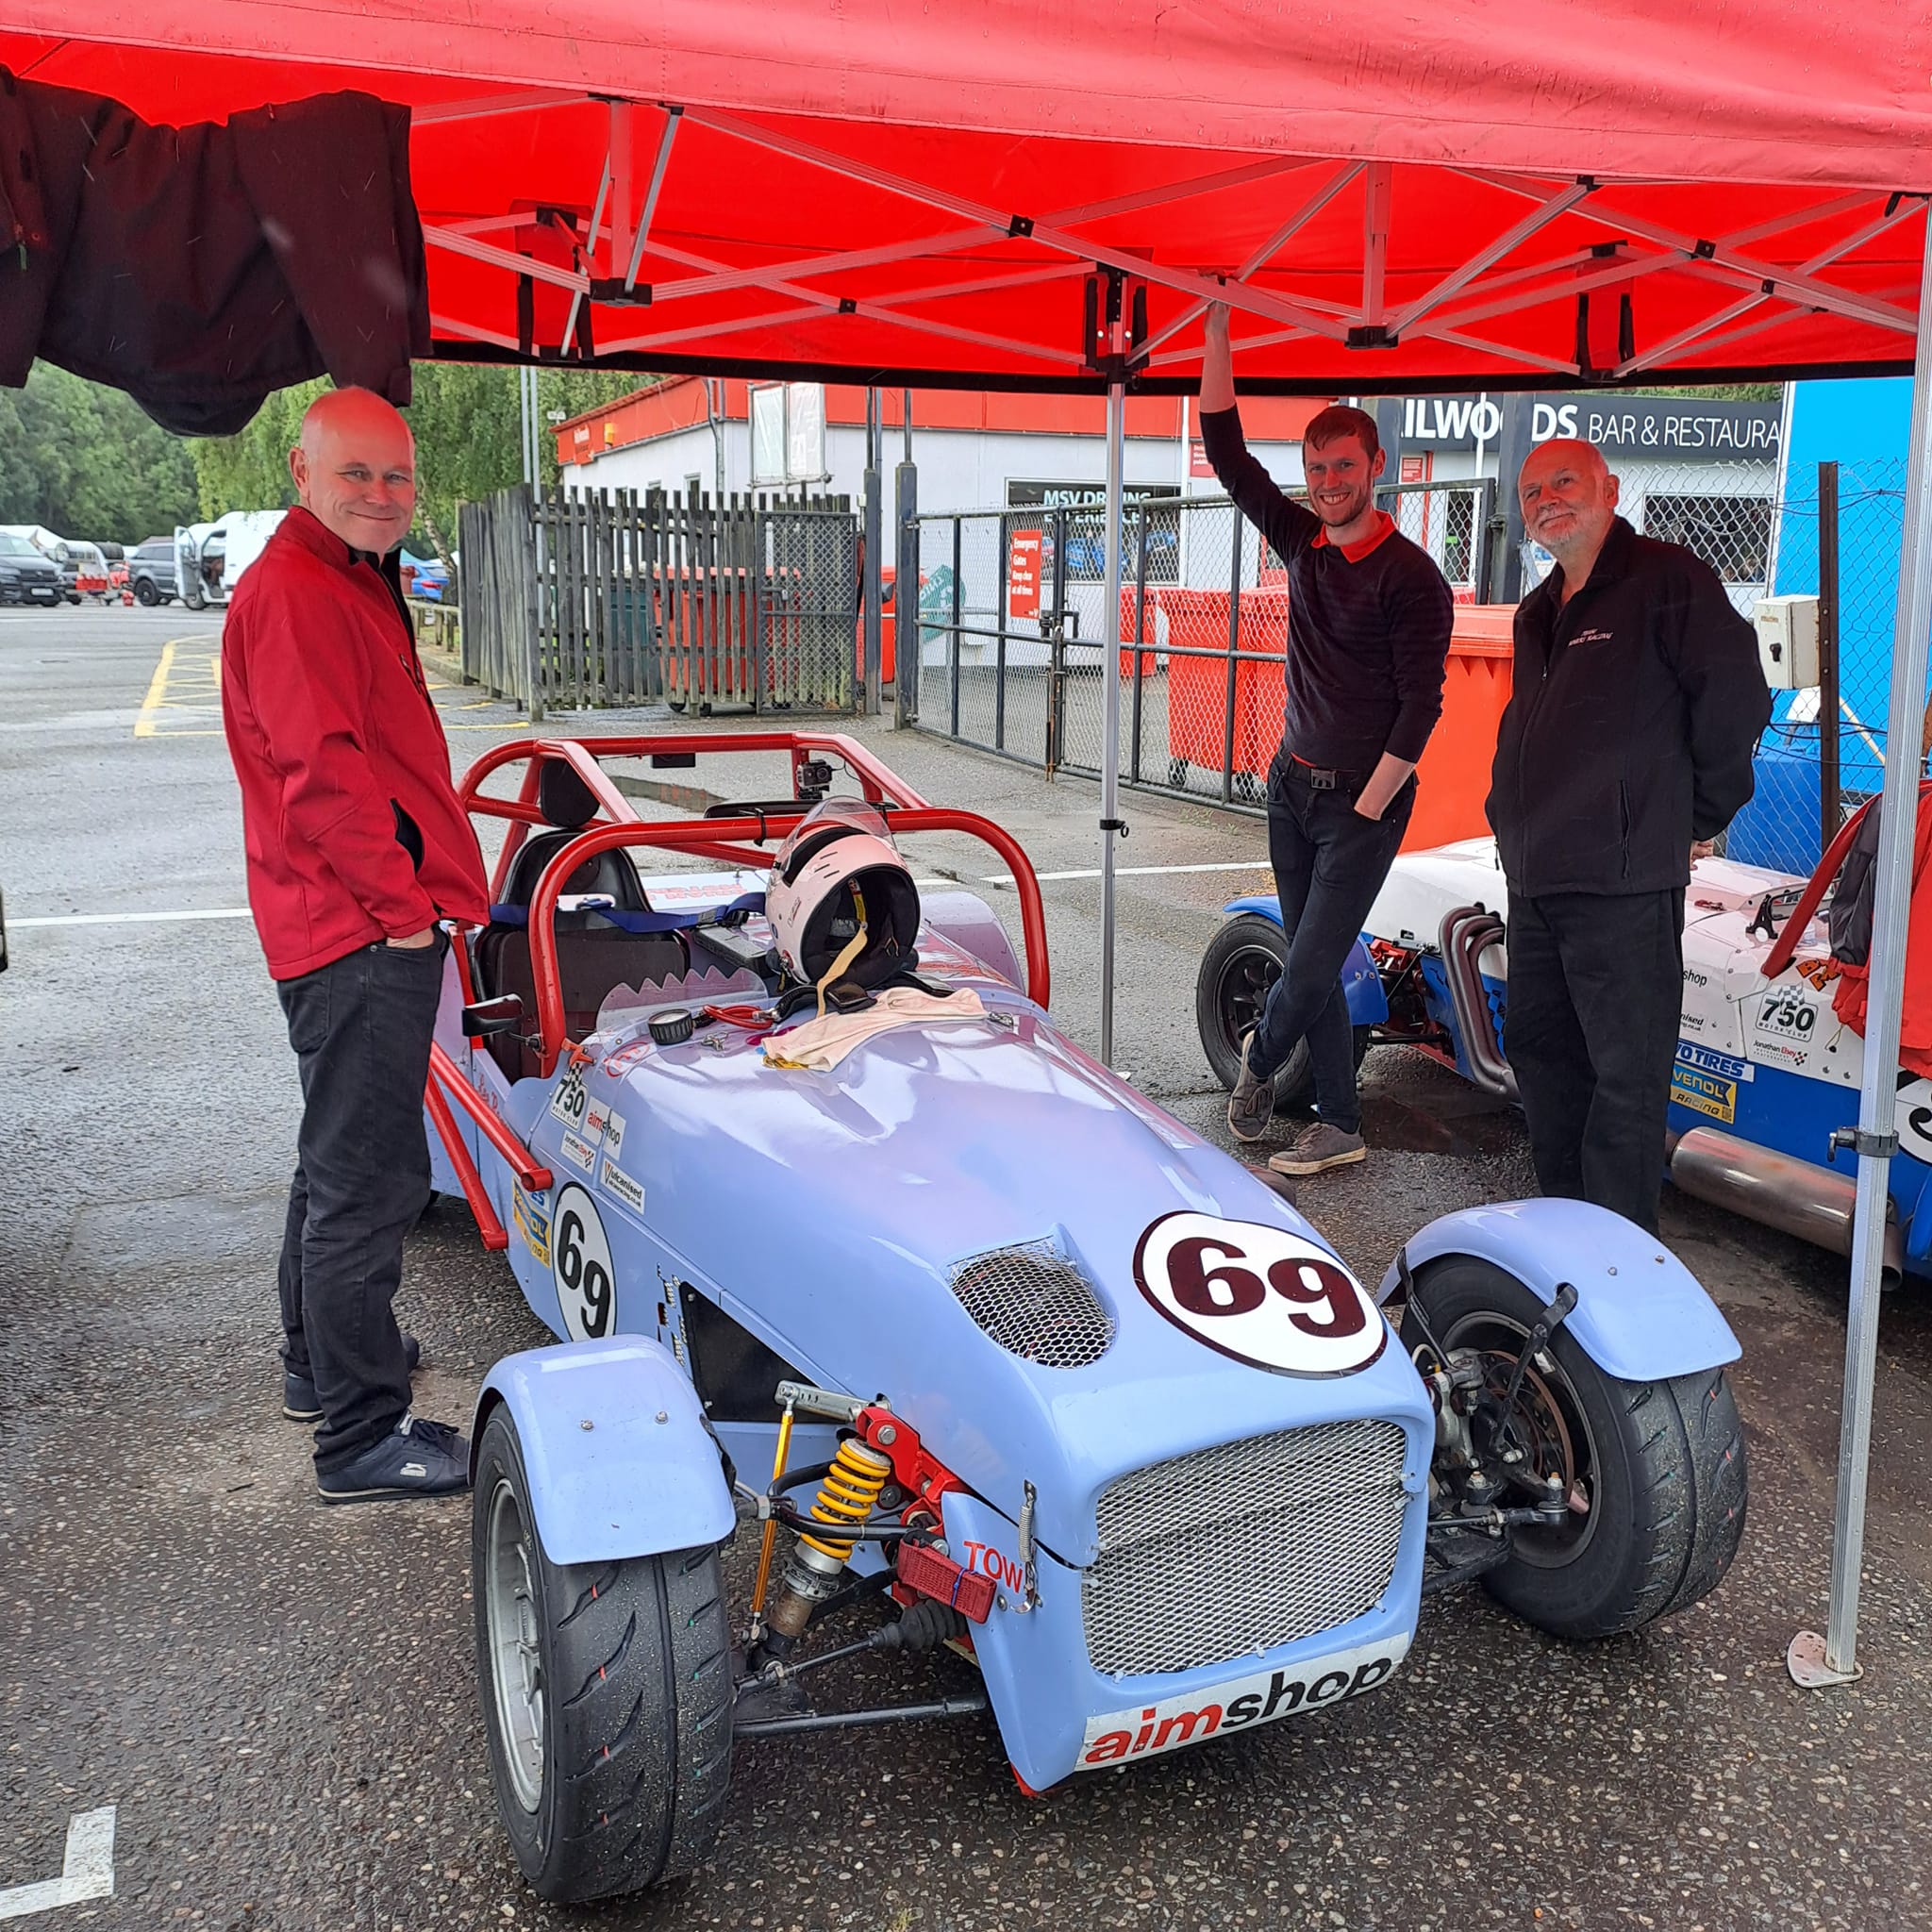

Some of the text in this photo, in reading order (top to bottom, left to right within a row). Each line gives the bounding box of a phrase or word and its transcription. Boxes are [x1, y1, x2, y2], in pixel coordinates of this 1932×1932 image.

[1401, 399, 1780, 448] ILWODS BAR & RESTAURA
[1043, 490, 1151, 506] MSV DRIN
[1762, 998, 1815, 1032] 750
[1695, 1049, 1745, 1077] TIRES
[555, 1080, 585, 1118] 750
[1673, 1070, 1724, 1099] VENOL
[1675, 1093, 1720, 1115] RACING
[558, 1209, 610, 1340] 69
[1167, 1237, 1366, 1338] 69
[963, 1541, 1024, 1594] TOW
[1085, 1657, 1393, 1763] aimshop
